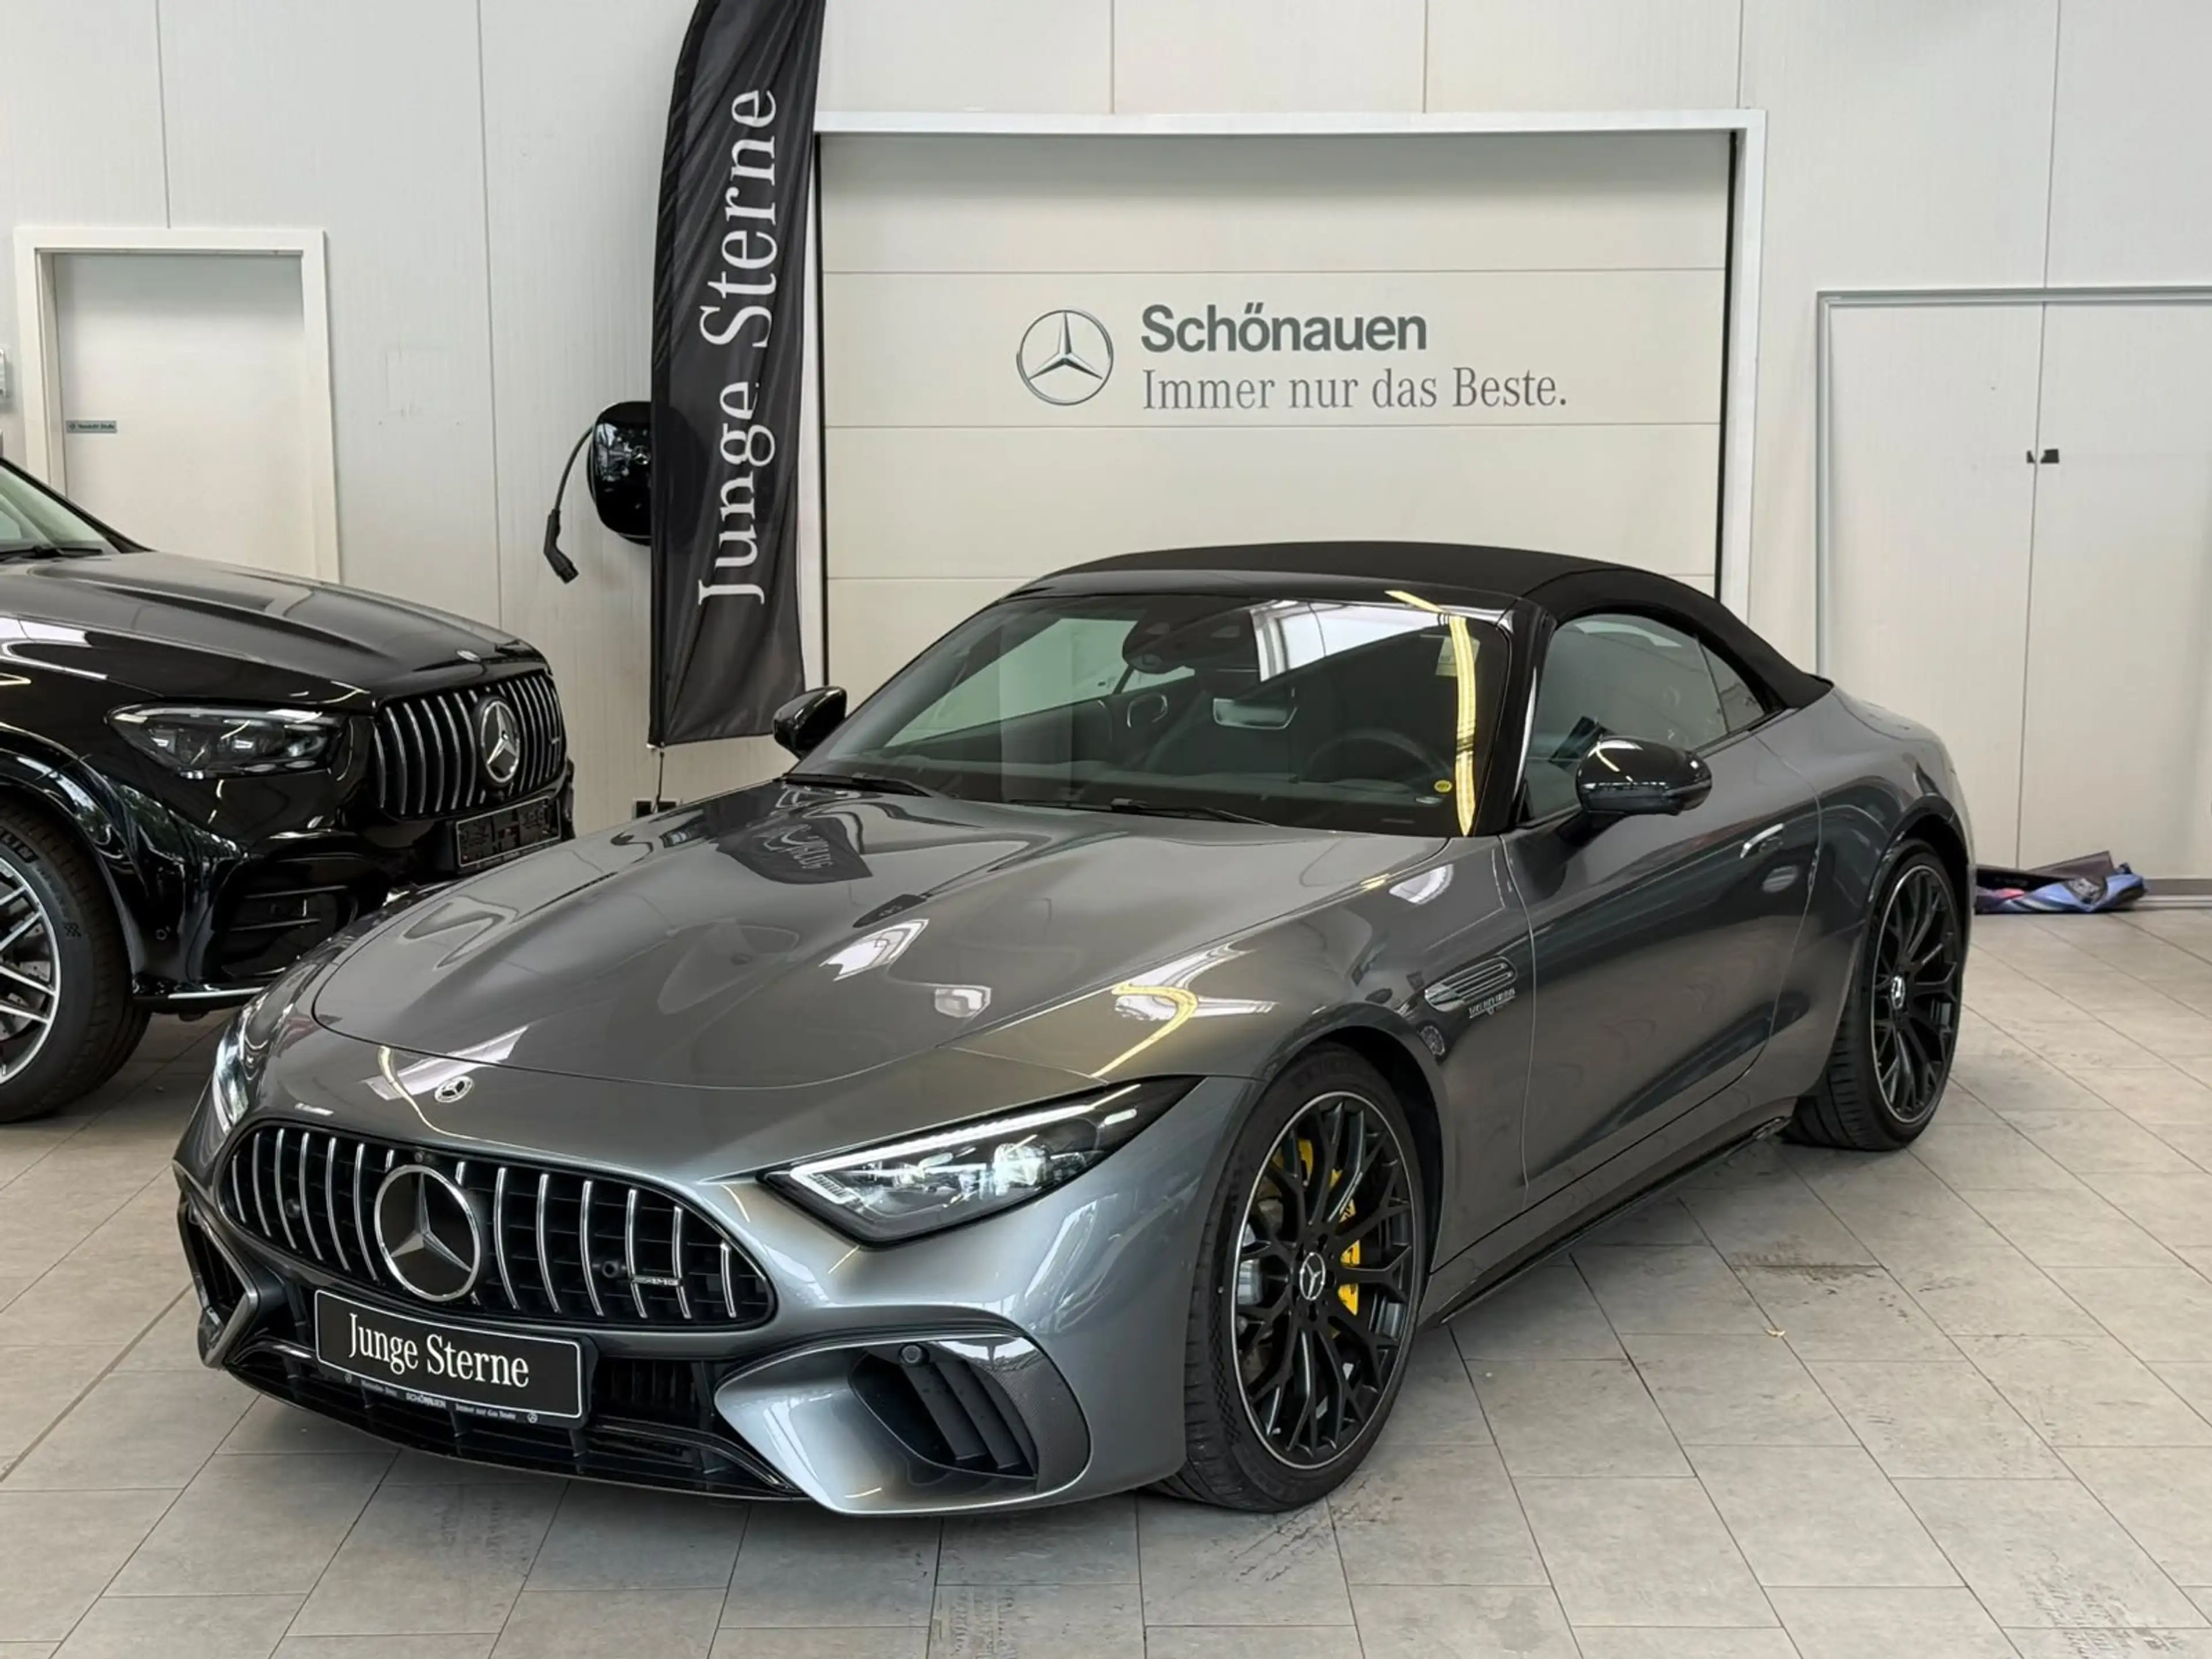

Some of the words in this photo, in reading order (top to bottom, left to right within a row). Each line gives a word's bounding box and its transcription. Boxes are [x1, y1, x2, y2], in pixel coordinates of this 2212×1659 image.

[699, 89, 778, 349] Sterne
[1141, 301, 1427, 353] Schönauen
[1142, 369, 1275, 410] Immer
[1288, 377, 1359, 409] nur
[1372, 367, 1437, 408] das
[1452, 366, 1567, 408] Beste.
[698, 381, 775, 606] Junge
[348, 1312, 419, 1376] Junge
[426, 1334, 529, 1388] Sterne
